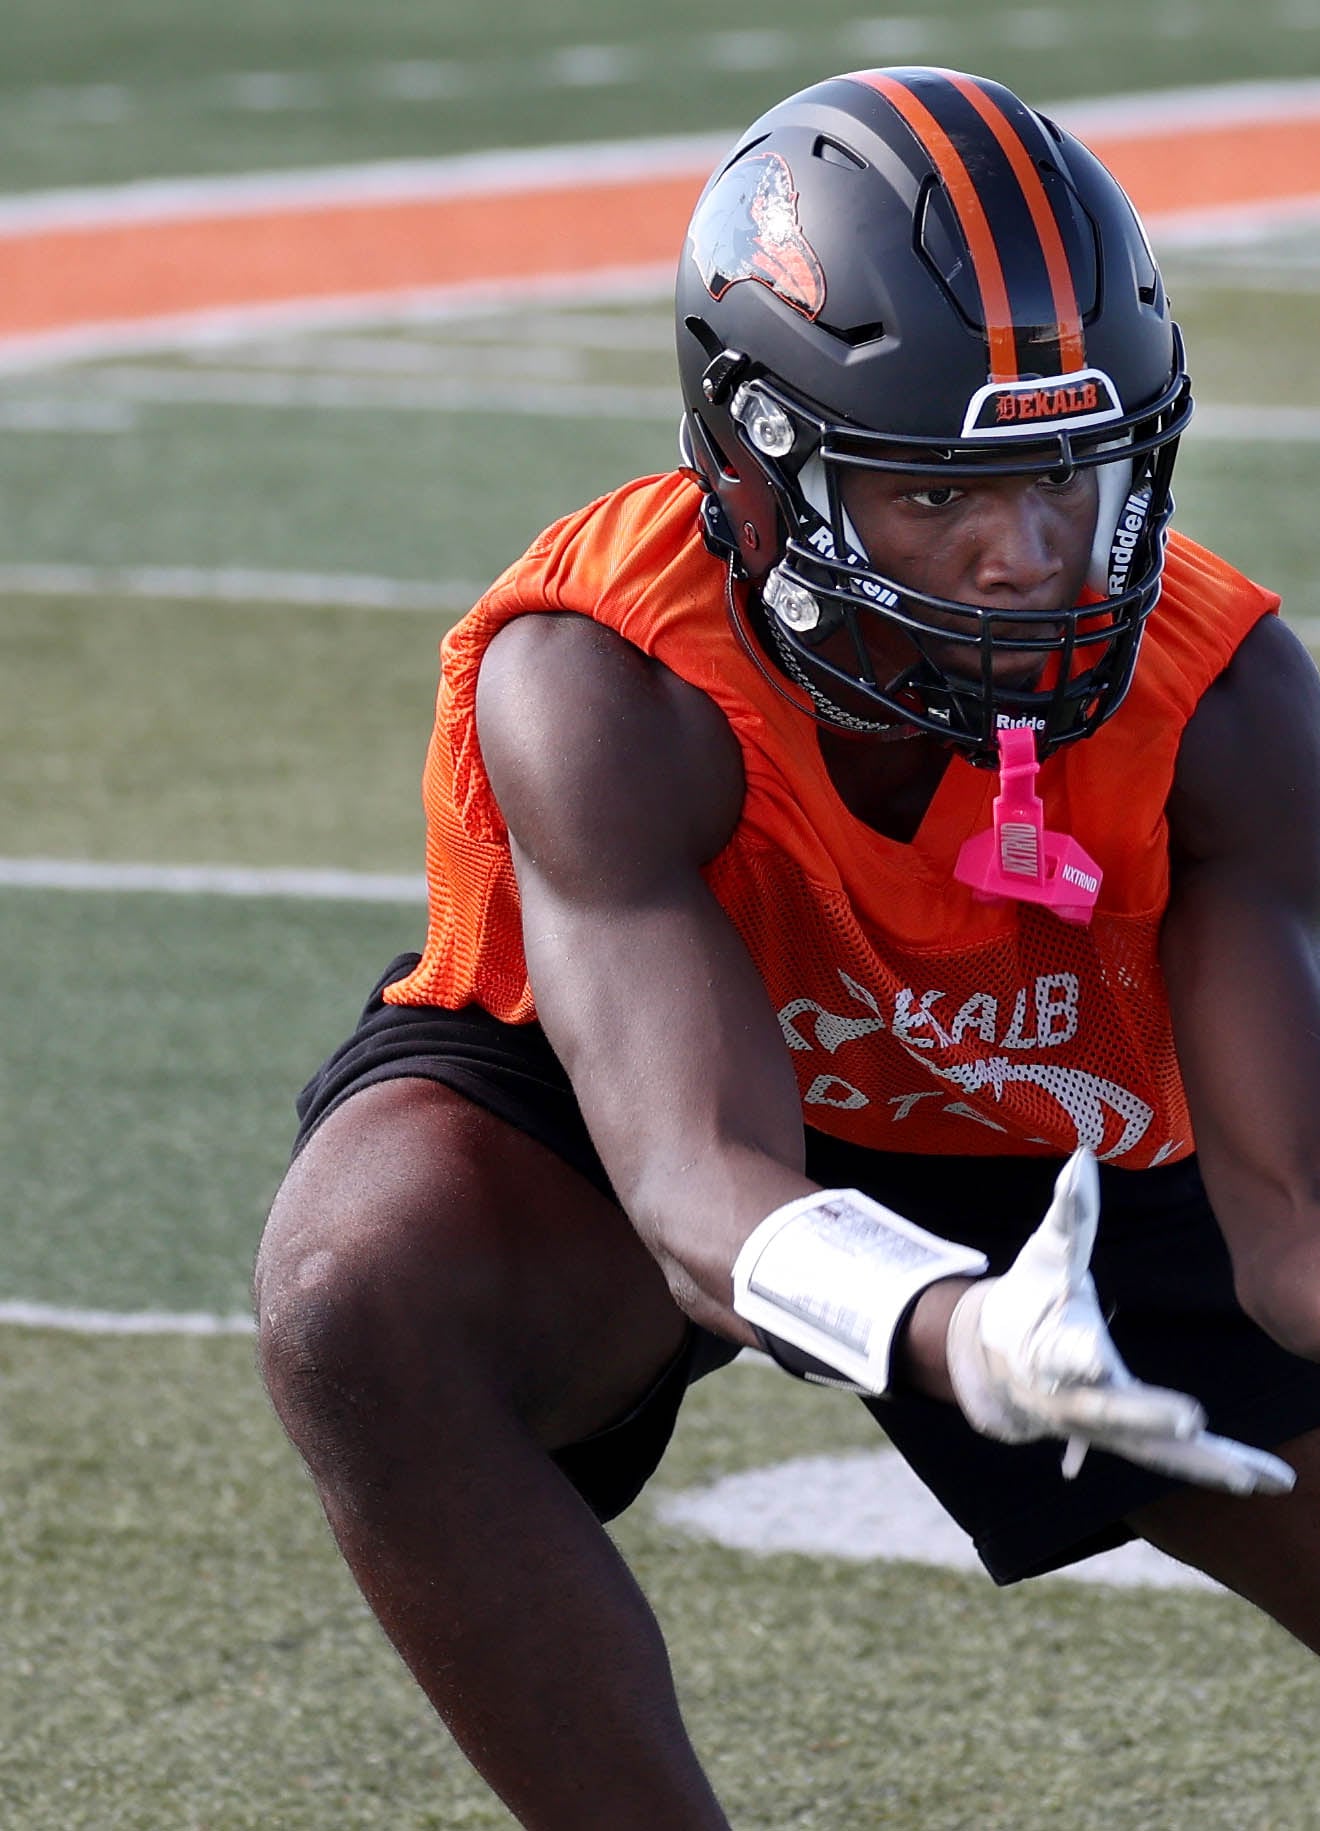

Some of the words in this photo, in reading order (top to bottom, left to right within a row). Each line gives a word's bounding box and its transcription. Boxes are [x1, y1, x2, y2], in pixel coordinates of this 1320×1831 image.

[996, 383, 1097, 421] DEKALB
[808, 525, 898, 607] Riell
[1109, 494, 1149, 596] Riddell
[1062, 863, 1097, 893] NXTRND
